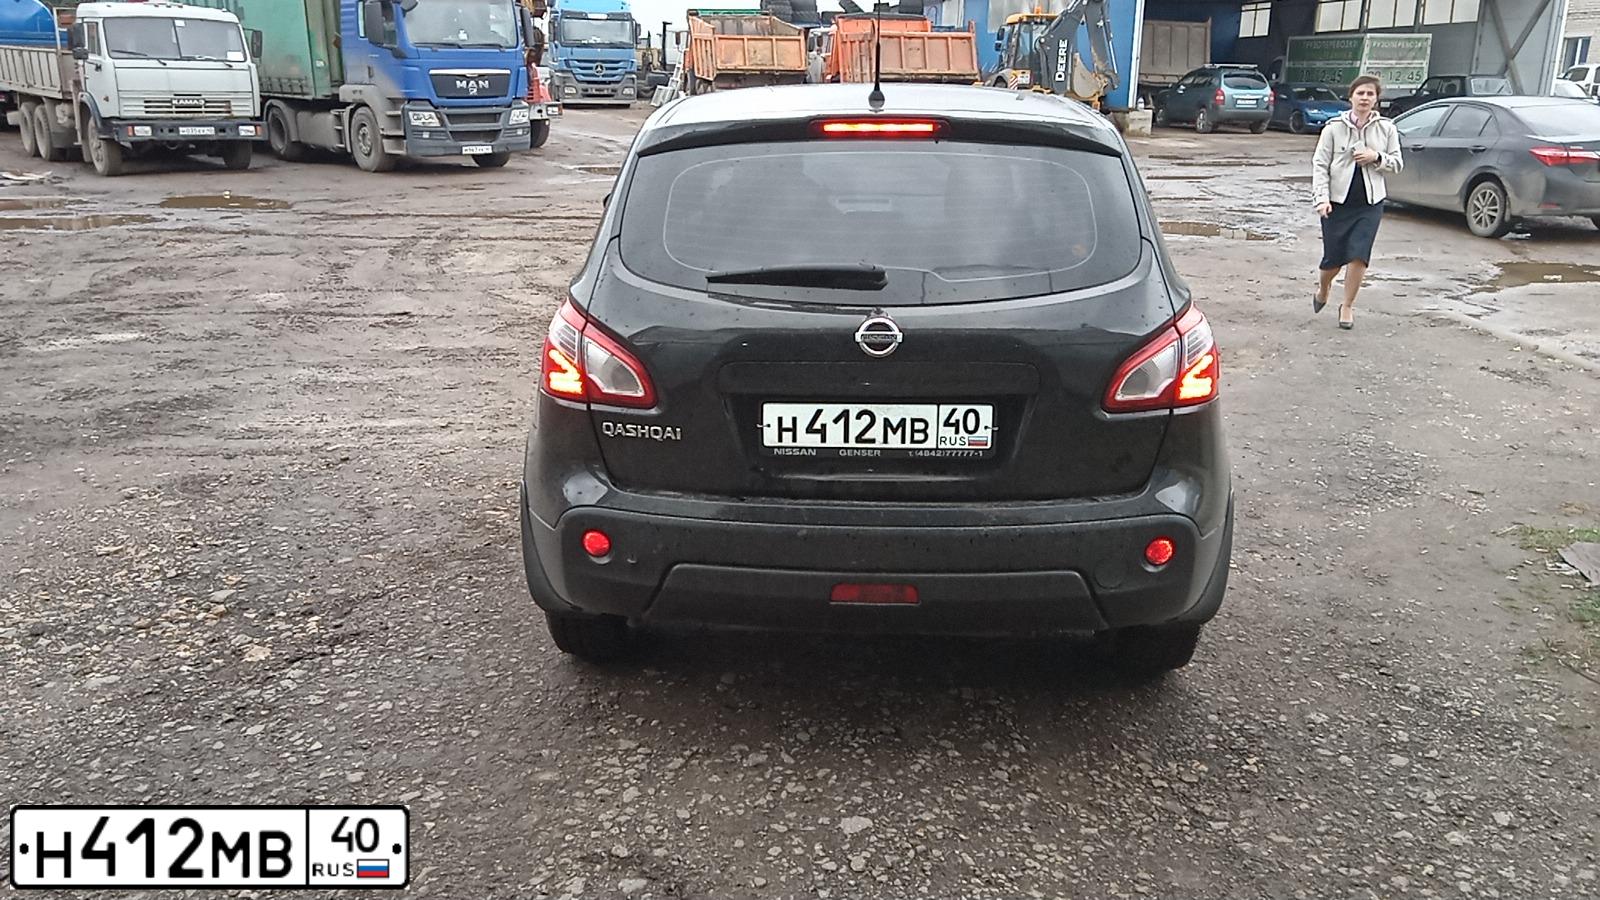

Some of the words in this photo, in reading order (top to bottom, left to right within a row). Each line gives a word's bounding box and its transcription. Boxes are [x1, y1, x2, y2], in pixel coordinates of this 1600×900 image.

[1055, 39, 1068, 82] DEERE
[455, 80, 490, 89] MAN
[942, 407, 981, 436] 40
[601, 421, 682, 442] QASHQAI
[939, 435, 967, 446] RUS
[773, 448, 817, 456] NISSAN
[838, 449, 882, 457] GENSER
